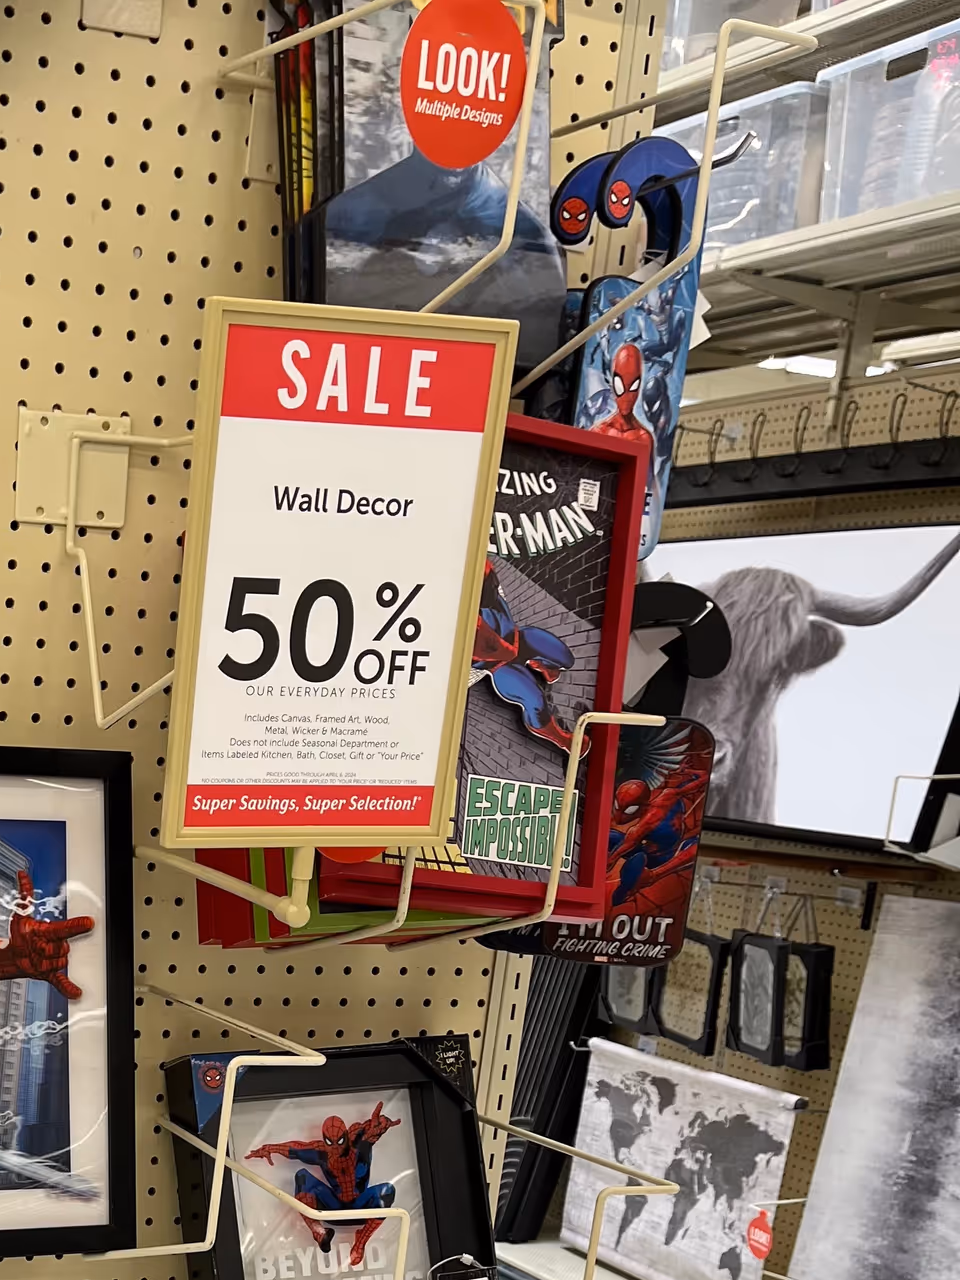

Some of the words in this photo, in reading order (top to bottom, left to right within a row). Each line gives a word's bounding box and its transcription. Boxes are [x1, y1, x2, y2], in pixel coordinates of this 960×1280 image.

[417, 39, 511, 102] LOOK!
[415, 97, 460, 121] Multiple
[461, 104, 503, 128] Designs
[277, 339, 438, 418] SALE
[495, 469, 557, 497] ZING
[273, 484, 329, 513] Wall
[336, 488, 414, 517] Decor
[353, 648, 431, 686] OFF
[245, 684, 275, 698] OUR
[279, 685, 346, 699] EVERYDAY
[350, 688, 397, 700] PRICES
[244, 713, 280, 724] Includes
[281, 714, 313, 725] Canvas,
[315, 714, 346, 725] Framed
[348, 715, 362, 725] Art,
[364, 716, 391, 726] Wood,
[264, 726, 289, 736] Metal,
[291, 726, 320, 736] Wicker
[321, 726, 328, 736] &
[330, 727, 369, 737] Macramé
[201, 750, 225, 759] Items
[226, 750, 259, 760] Labeled
[261, 750, 294, 761] Kitchen,
[296, 751, 317, 761] Bath,
[319, 751, 347, 761] Closet,
[349, 751, 365, 761] Gift
[366, 753, 376, 761] or
[378, 752, 399, 761] "Your
[400, 752, 424, 761] Price"
[229, 737, 251, 748] Does
[253, 738, 268, 747] not
[269, 738, 300, 748] include
[301, 738, 339, 749] Seasonal
[340, 739, 389, 750] Department
[390, 741, 400, 749] or
[192, 795, 236, 815] Super
[238, 796, 300, 815] Savings,
[302, 796, 347, 815] Super
[467, 777, 566, 817] ESCAPE
[612, 914, 675, 943] OUT
[552, 938, 619, 956] FIGHTING
[621, 941, 672, 960] CRIME
